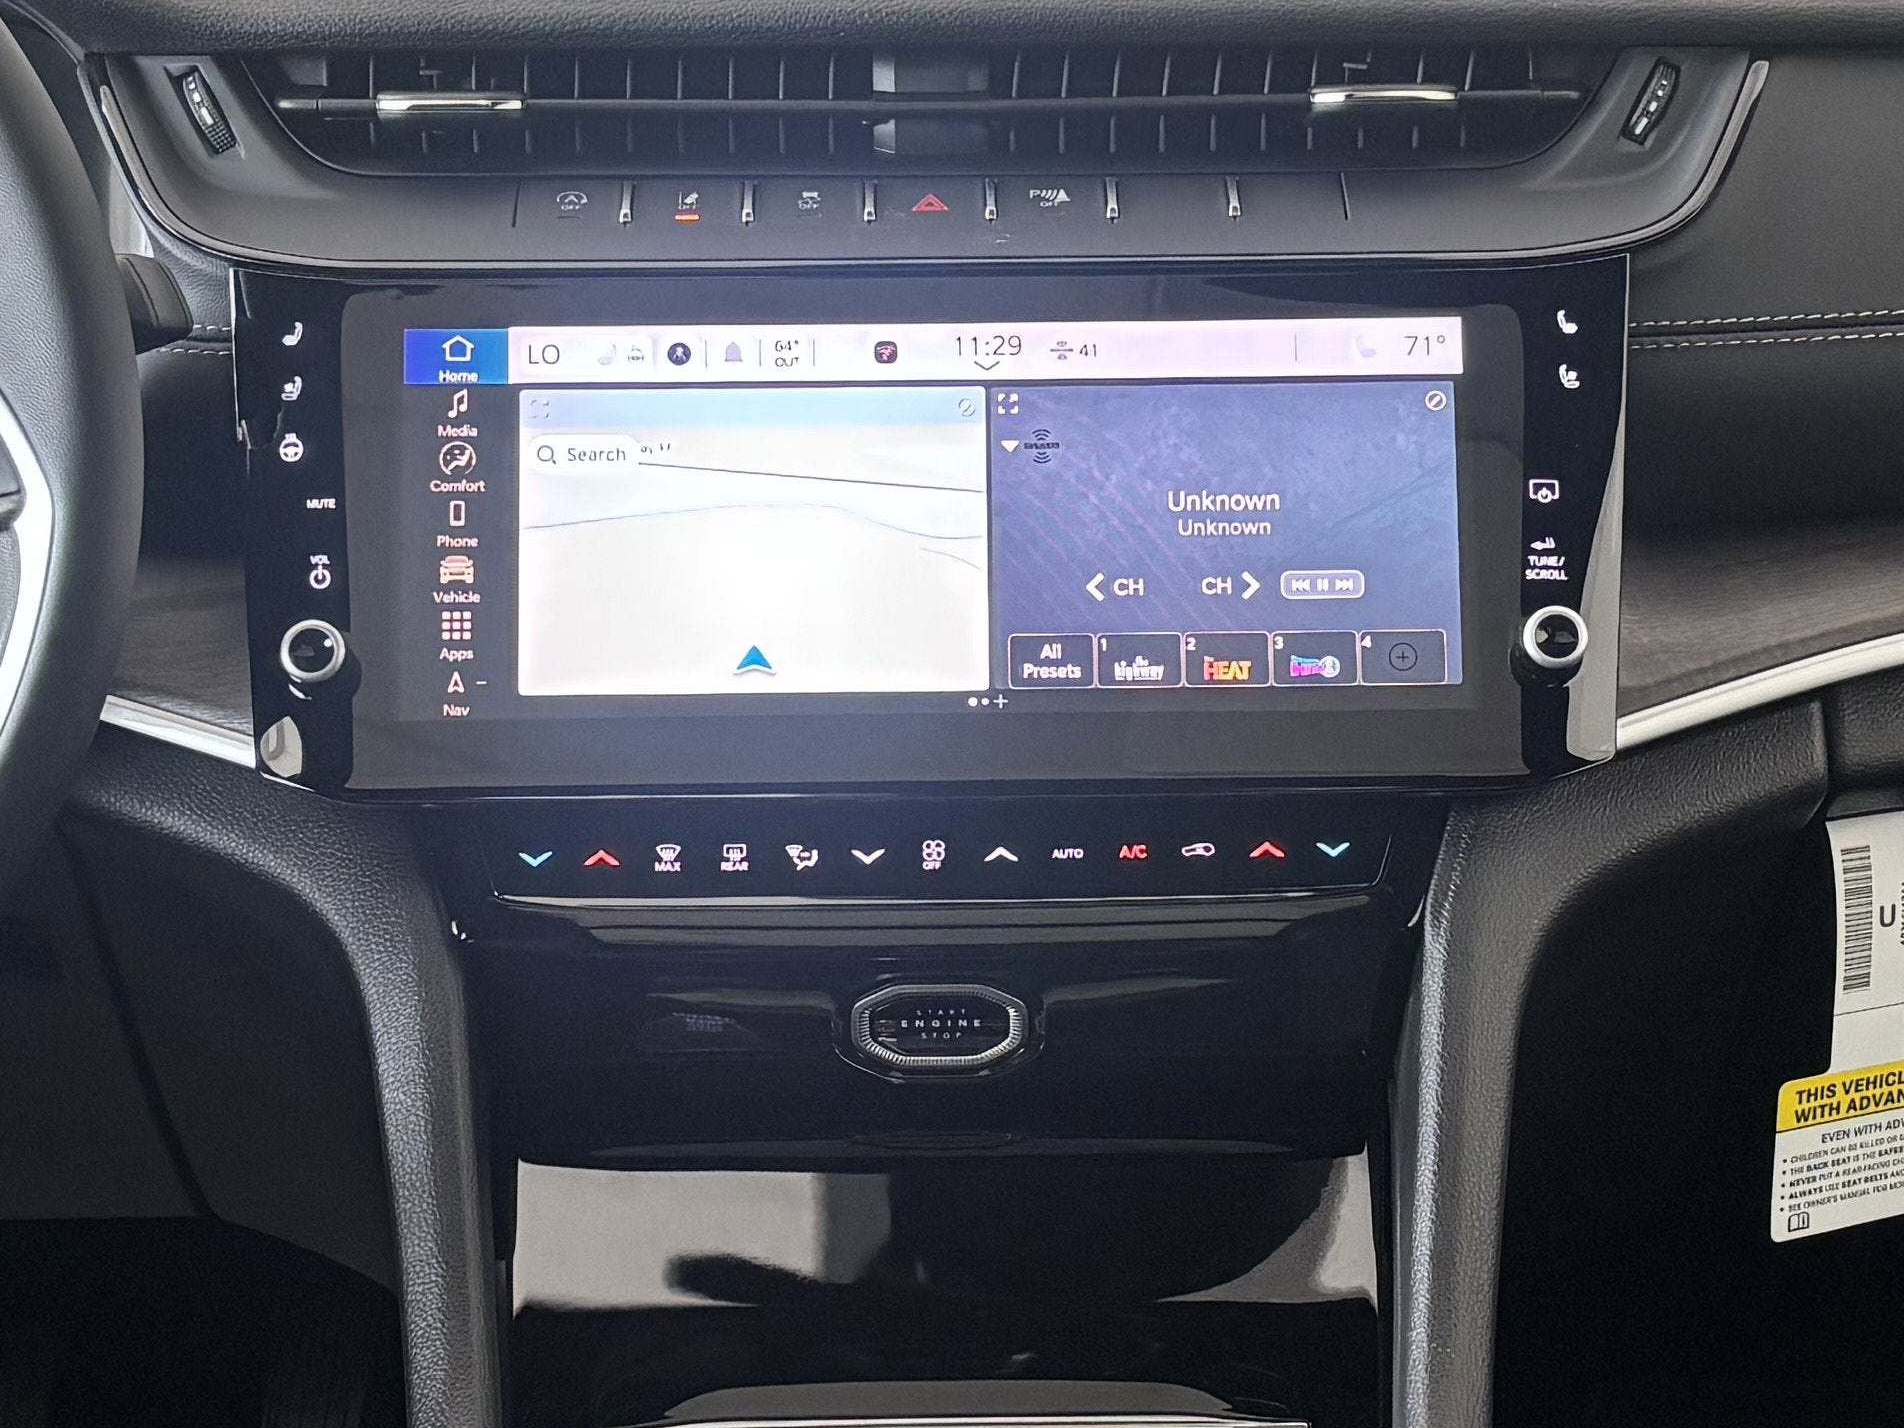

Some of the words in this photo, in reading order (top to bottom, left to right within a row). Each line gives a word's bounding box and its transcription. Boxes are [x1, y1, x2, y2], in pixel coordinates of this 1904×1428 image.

[956, 336, 1022, 356] 11:29
[1404, 335, 1445, 356] 71°
[528, 344, 560, 364] LO
[774, 356, 799, 367] OUT
[439, 369, 478, 383] Home
[437, 424, 478, 438] Media
[567, 447, 626, 463] Search
[430, 479, 485, 493] Comfort
[306, 498, 336, 508] MUTE
[1167, 490, 1280, 512] Unknown
[1177, 519, 1271, 536] Unknown
[436, 534, 478, 548] Phone
[310, 555, 330, 564] VOL
[1525, 569, 1568, 580] SCROLL
[1113, 578, 1144, 596] CH
[1201, 577, 1232, 595] CH
[433, 590, 480, 604] Vehicle
[1100, 638, 1107, 652] 1
[1186, 638, 1196, 651] 2
[1274, 637, 1284, 649] 3
[440, 648, 474, 661] Apps
[1040, 644, 1062, 660] All
[1023, 662, 1082, 678] Presets
[1203, 660, 1251, 681] HEAT
[443, 703, 470, 716] Nav
[1052, 848, 1083, 859] AUTO
[1119, 844, 1148, 859] A/C
[654, 861, 680, 872] MAX
[721, 861, 748, 871] REAR
[922, 861, 941, 870] OFF
[1880, 904, 1896, 927] U
[901, 1019, 981, 1028] ENGINE
[1796, 1084, 1836, 1105] THIS
[1794, 1101, 1840, 1123] WITH
[1821, 1129, 1851, 1144] EVEN
[1854, 1123, 1882, 1137] WITH
[1790, 1149, 1828, 1164] CHILDREN
[1830, 1145, 1846, 1155] CAN
[1859, 1137, 1885, 1149] KILLED
[1887, 1135, 1897, 1143] OR
[1790, 1166, 1804, 1176] THE
[1806, 1162, 1829, 1172] BACK
[1831, 1157, 1851, 1168] SEAT
[1862, 1151, 1876, 1160] THE
[1788, 1186, 1823, 1199] ALWAYS
[1841, 1178, 1862, 1189] SEAT
[1864, 1173, 1888, 1184] BELTS
[1789, 1176, 1817, 1187] NEVER
